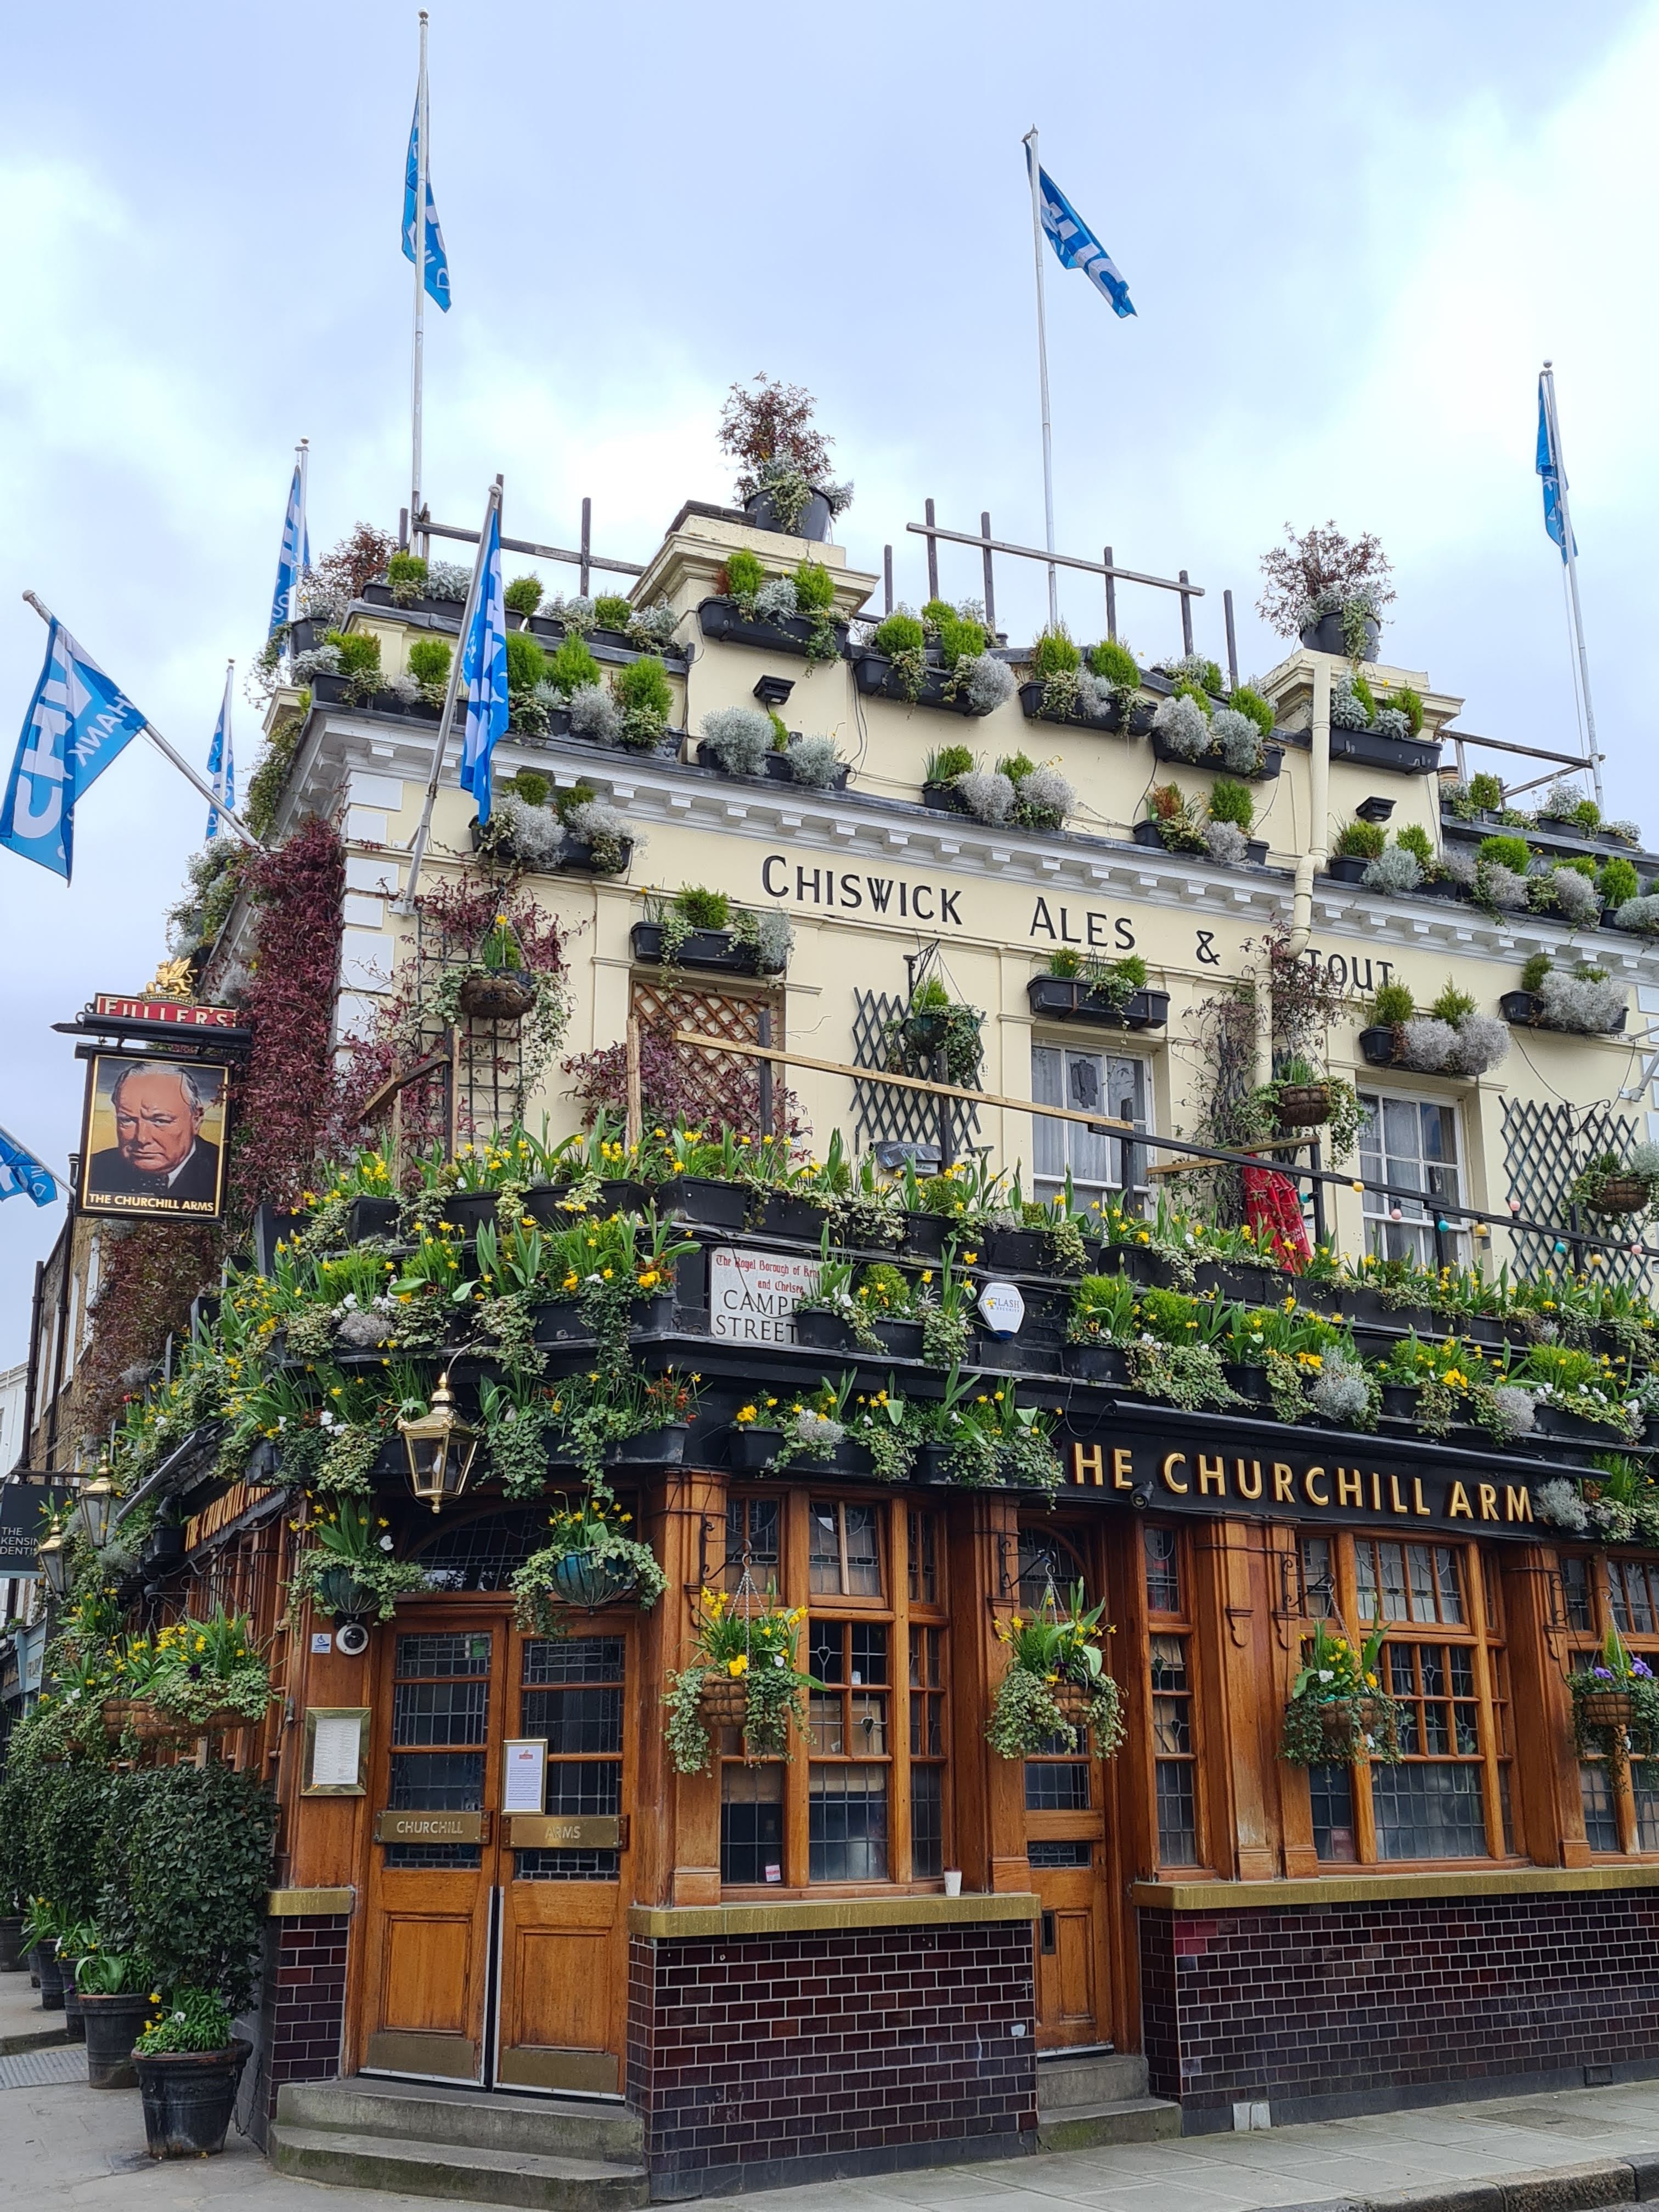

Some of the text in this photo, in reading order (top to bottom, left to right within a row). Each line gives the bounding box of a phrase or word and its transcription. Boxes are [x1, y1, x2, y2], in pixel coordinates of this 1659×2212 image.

[762, 855, 963, 926] CHISWICK
[1029, 896, 1136, 950] ALES
[1196, 930, 1220, 966] &
[89, 1193, 214, 1211] THE CHURCHILL ARMS
[716, 1255, 731, 1266] The
[735, 1256, 755, 1272] Royal
[760, 1260, 789, 1277] Borough
[793, 1266, 801, 1276] of
[758, 1279, 770, 1290] and
[724, 1290, 802, 1315] CAMP
[716, 1314, 798, 1344] STREET
[1073, 1442, 1534, 1523] HE CHURCHILL ARM
[1, 1527, 23, 1536] THE
[0, 1546, 33, 1555] DENTI
[1, 1537, 38, 1546] KENSIN
[396, 1820, 581, 1839] CHURCHILL ARMS
